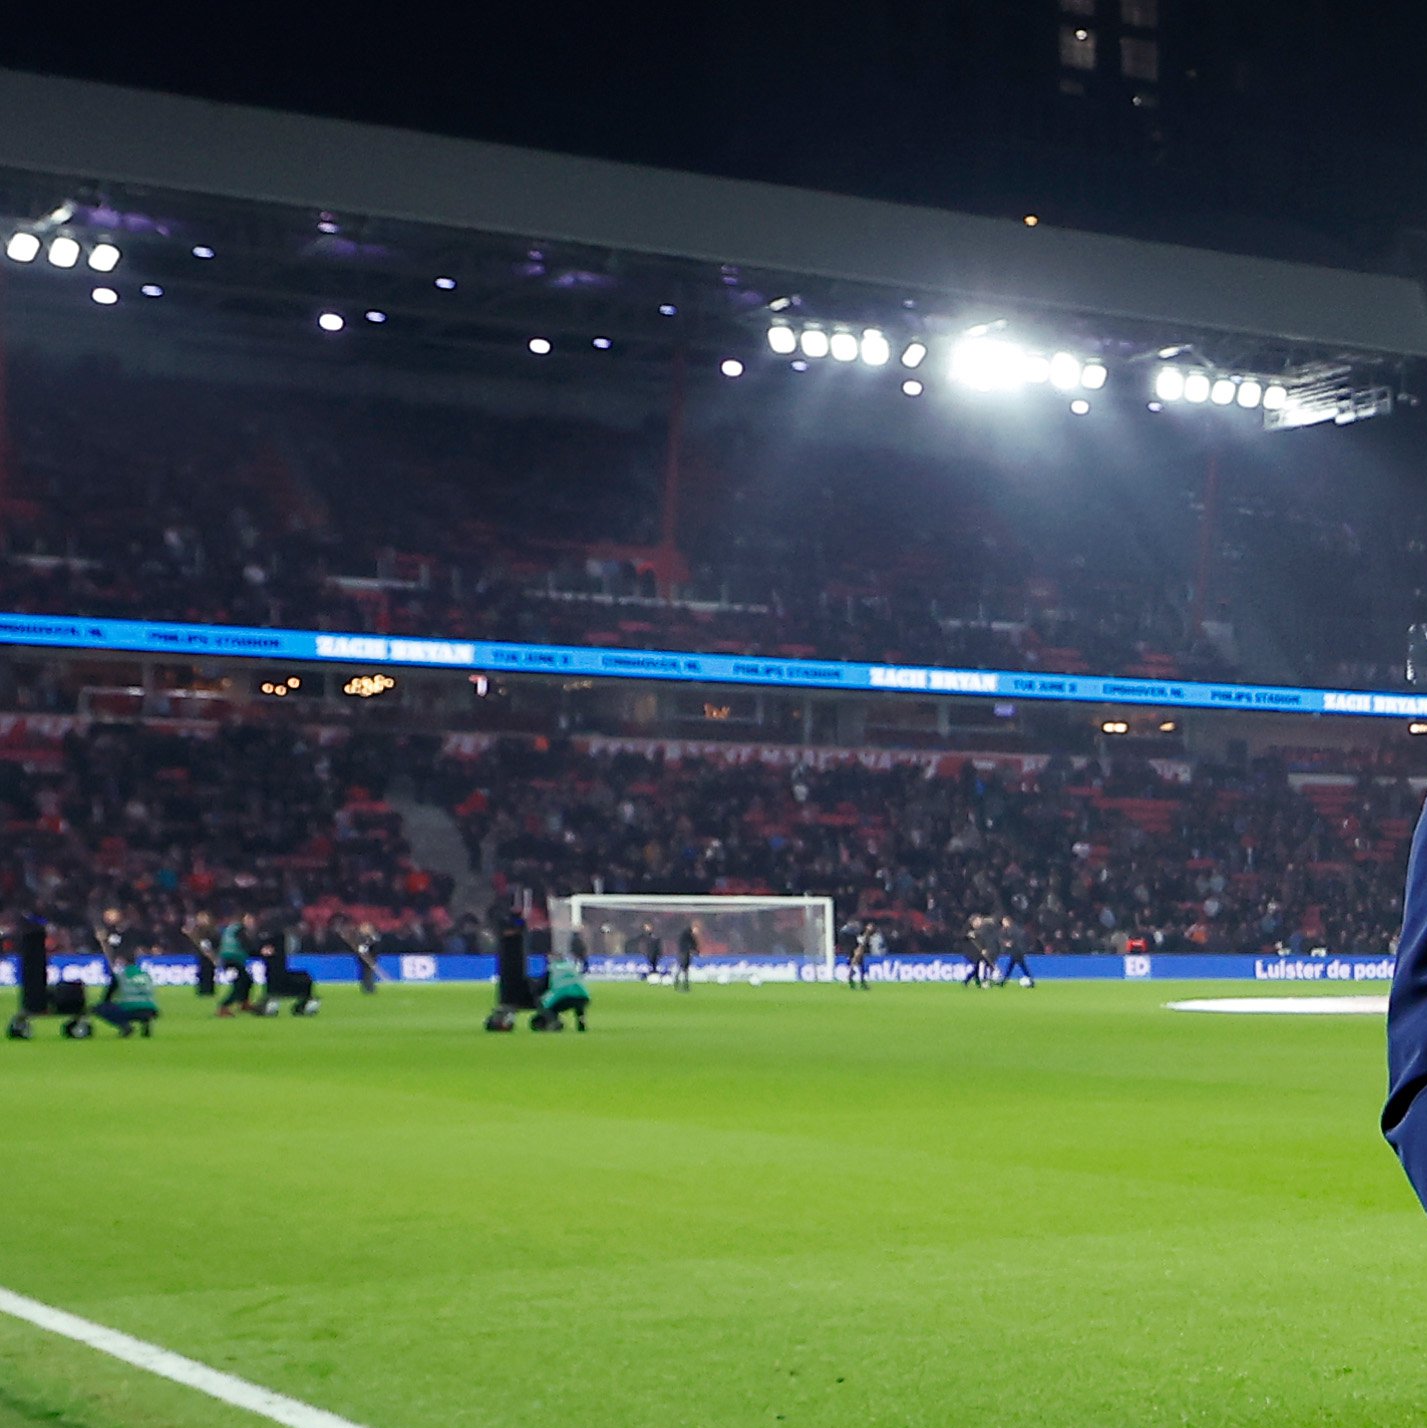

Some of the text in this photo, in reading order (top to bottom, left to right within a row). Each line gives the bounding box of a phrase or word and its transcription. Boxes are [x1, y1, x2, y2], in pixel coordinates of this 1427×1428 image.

[870, 667, 997, 691] ZACH BRYAN
[1324, 693, 1371, 712] ZACH
[1124, 955, 1149, 977] ED
[1255, 959, 1324, 980] Luister
[1327, 959, 1351, 980] de
